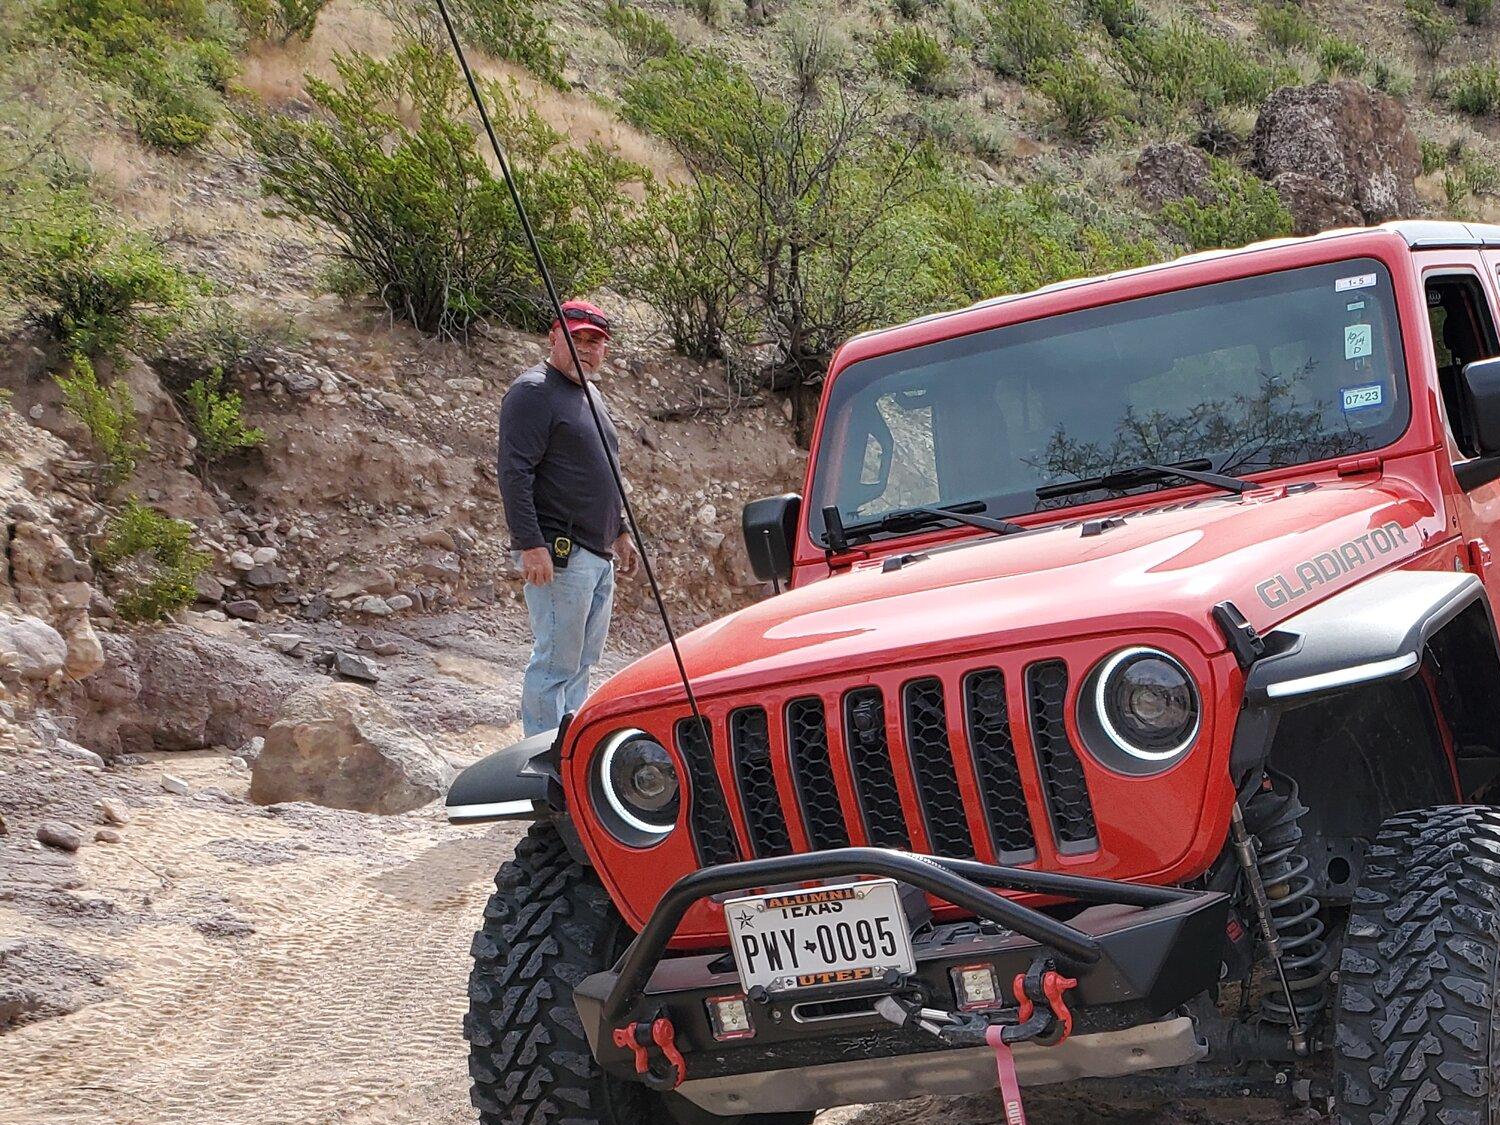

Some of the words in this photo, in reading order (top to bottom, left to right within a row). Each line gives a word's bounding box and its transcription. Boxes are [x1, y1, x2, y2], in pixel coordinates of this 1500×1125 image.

[1365, 391, 1379, 402] 23
[1256, 522, 1408, 609] GLADIATOR
[768, 889, 855, 909] ALUMNI
[781, 901, 843, 920] TEXAS
[800, 968, 872, 986] UTEP
